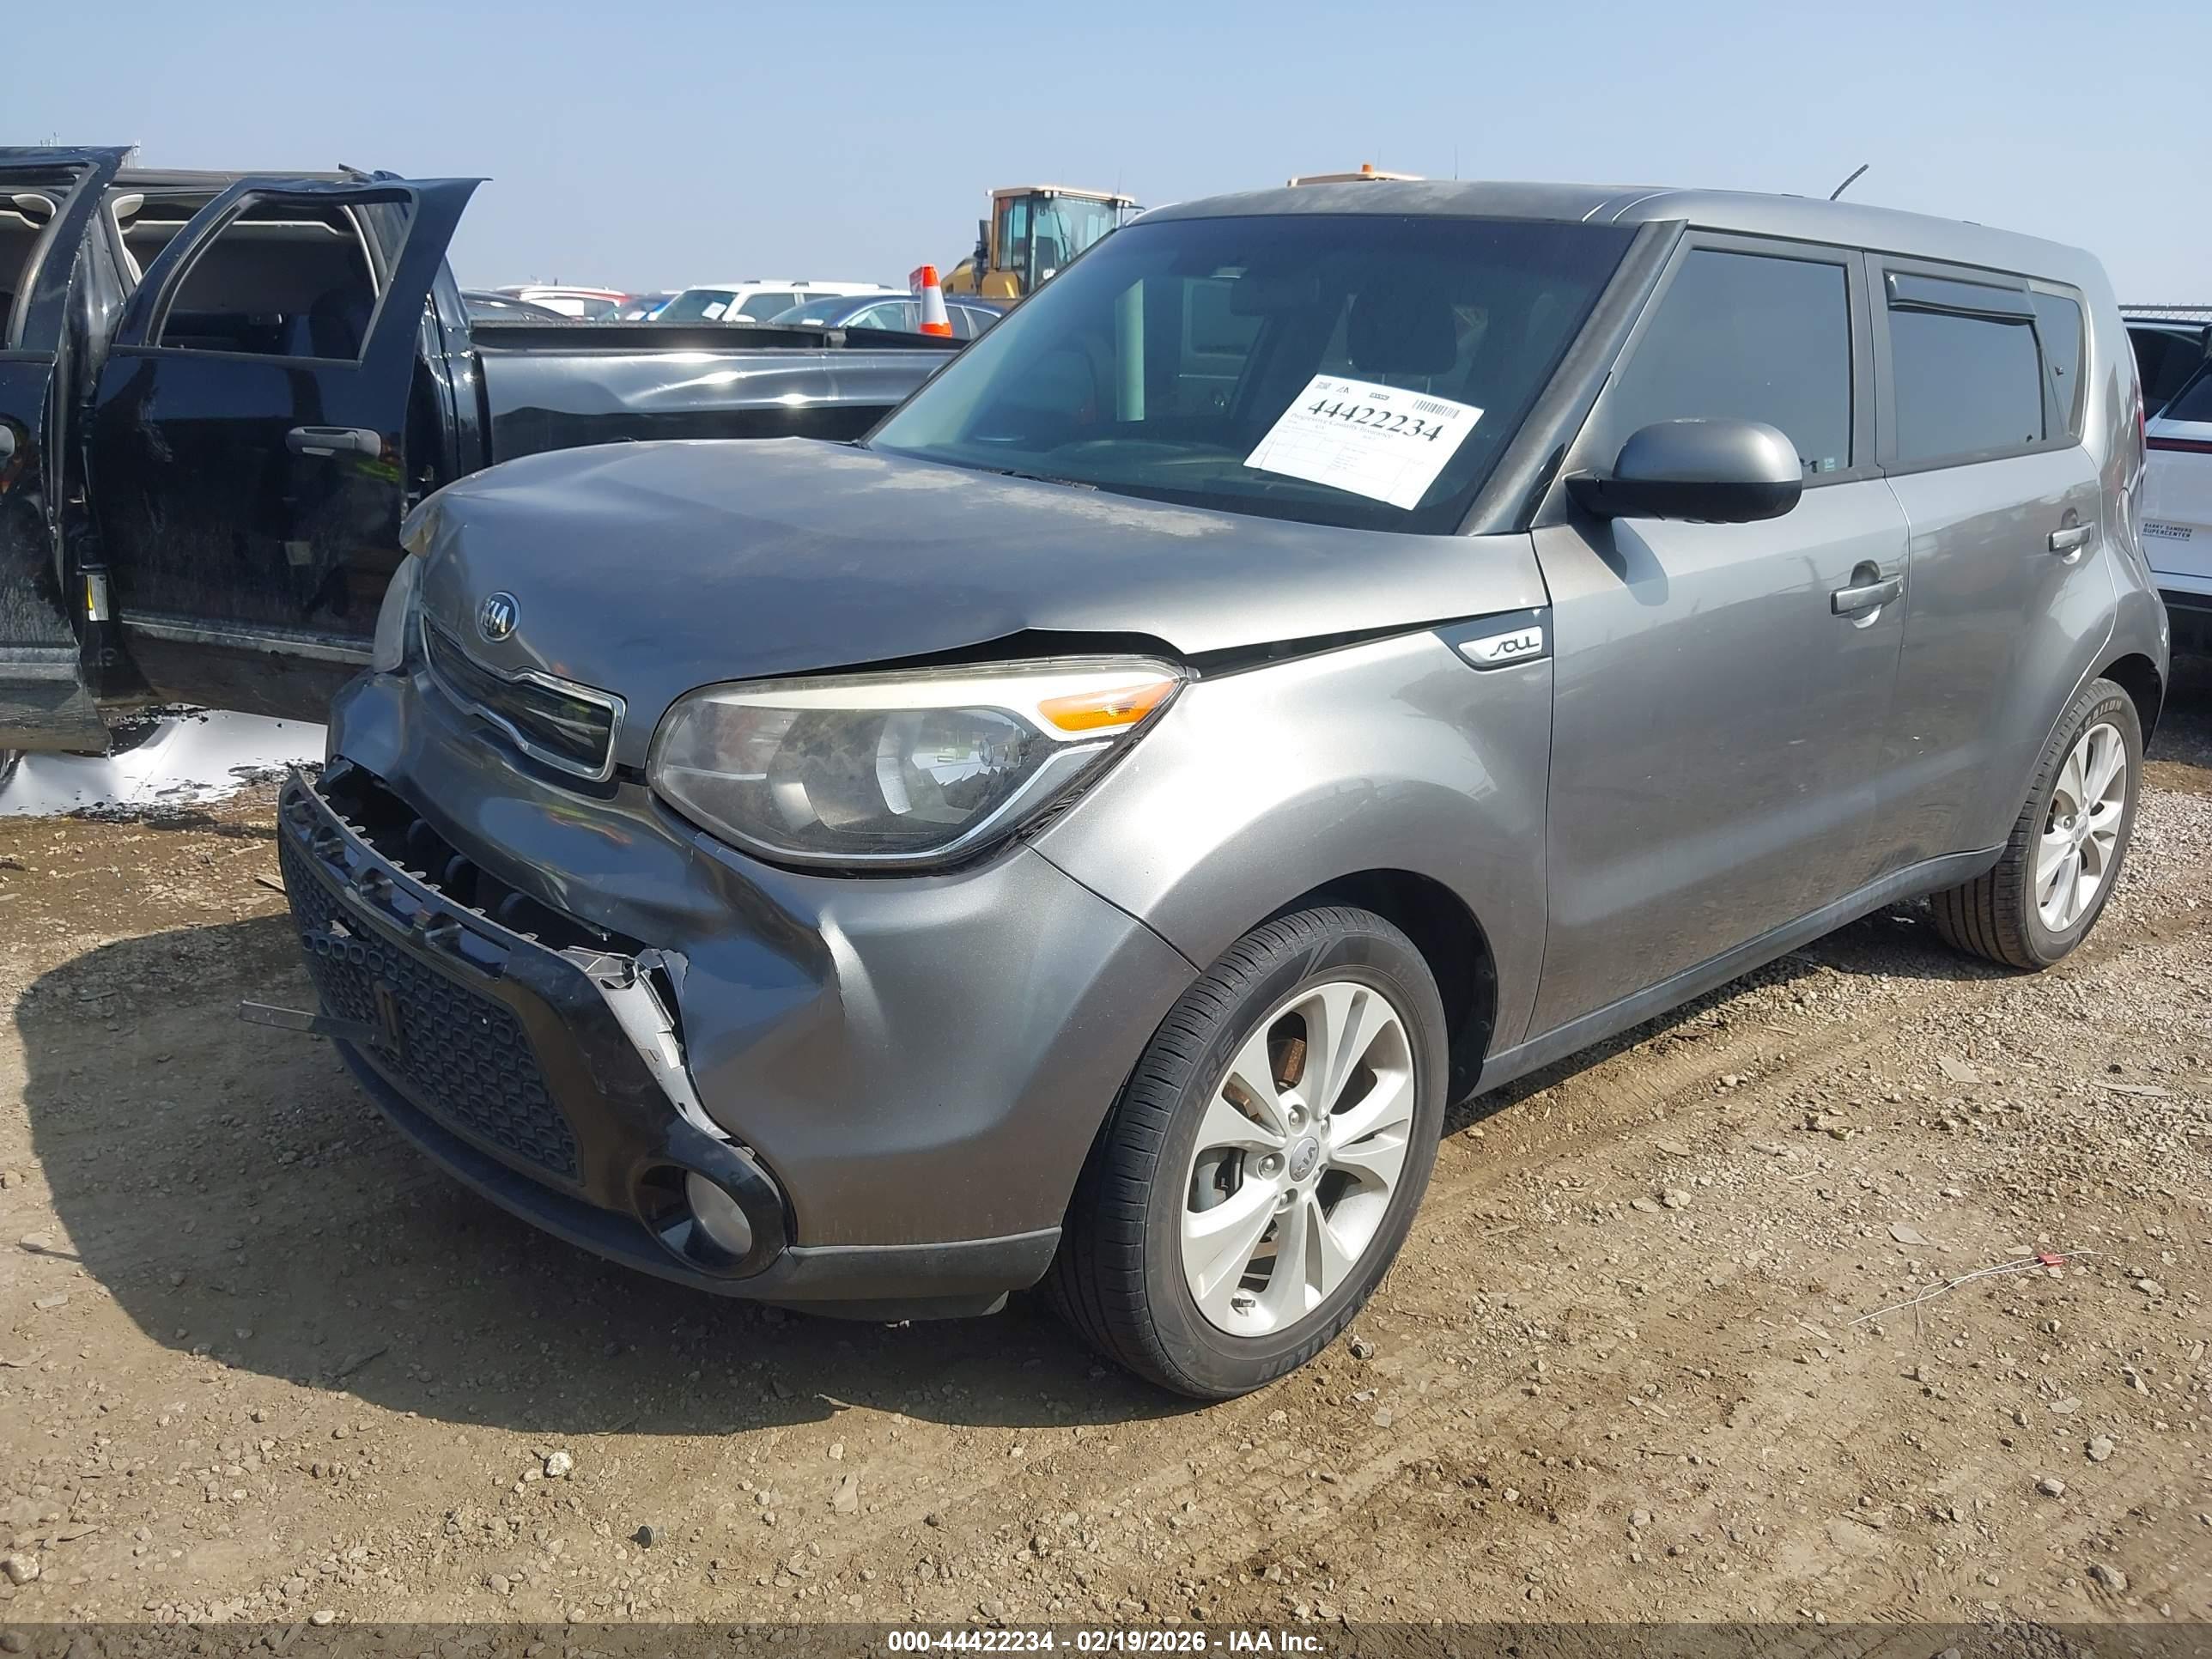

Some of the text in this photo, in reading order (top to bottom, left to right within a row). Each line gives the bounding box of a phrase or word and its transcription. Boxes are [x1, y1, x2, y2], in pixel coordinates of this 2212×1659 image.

[1308, 398, 1445, 442] 44422234
[2142, 528, 2191, 538] SUPERCENTER
[1489, 635, 1540, 658] SOUL
[1292, 1146, 1316, 1179] KIA
